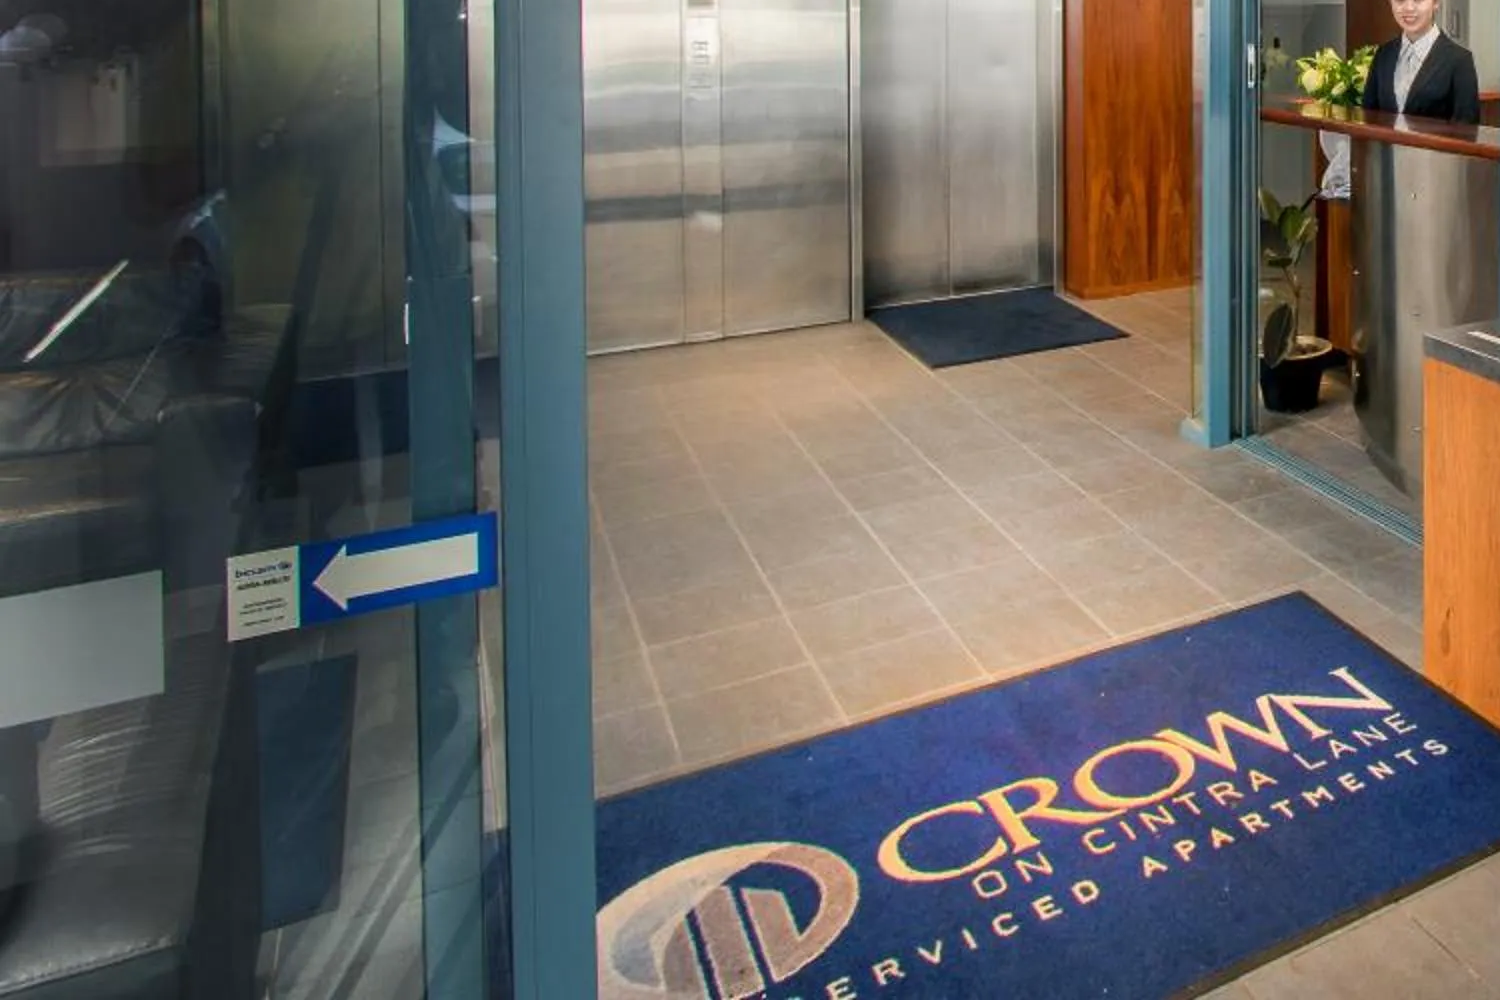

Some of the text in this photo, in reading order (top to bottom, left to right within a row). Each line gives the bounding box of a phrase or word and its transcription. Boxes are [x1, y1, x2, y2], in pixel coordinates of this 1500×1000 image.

[785, 738, 1449, 1000] ERVICED APARTMENTS
[877, 667, 1394, 883] CROWN
[971, 712, 1419, 900] ON CINTRA LANE
